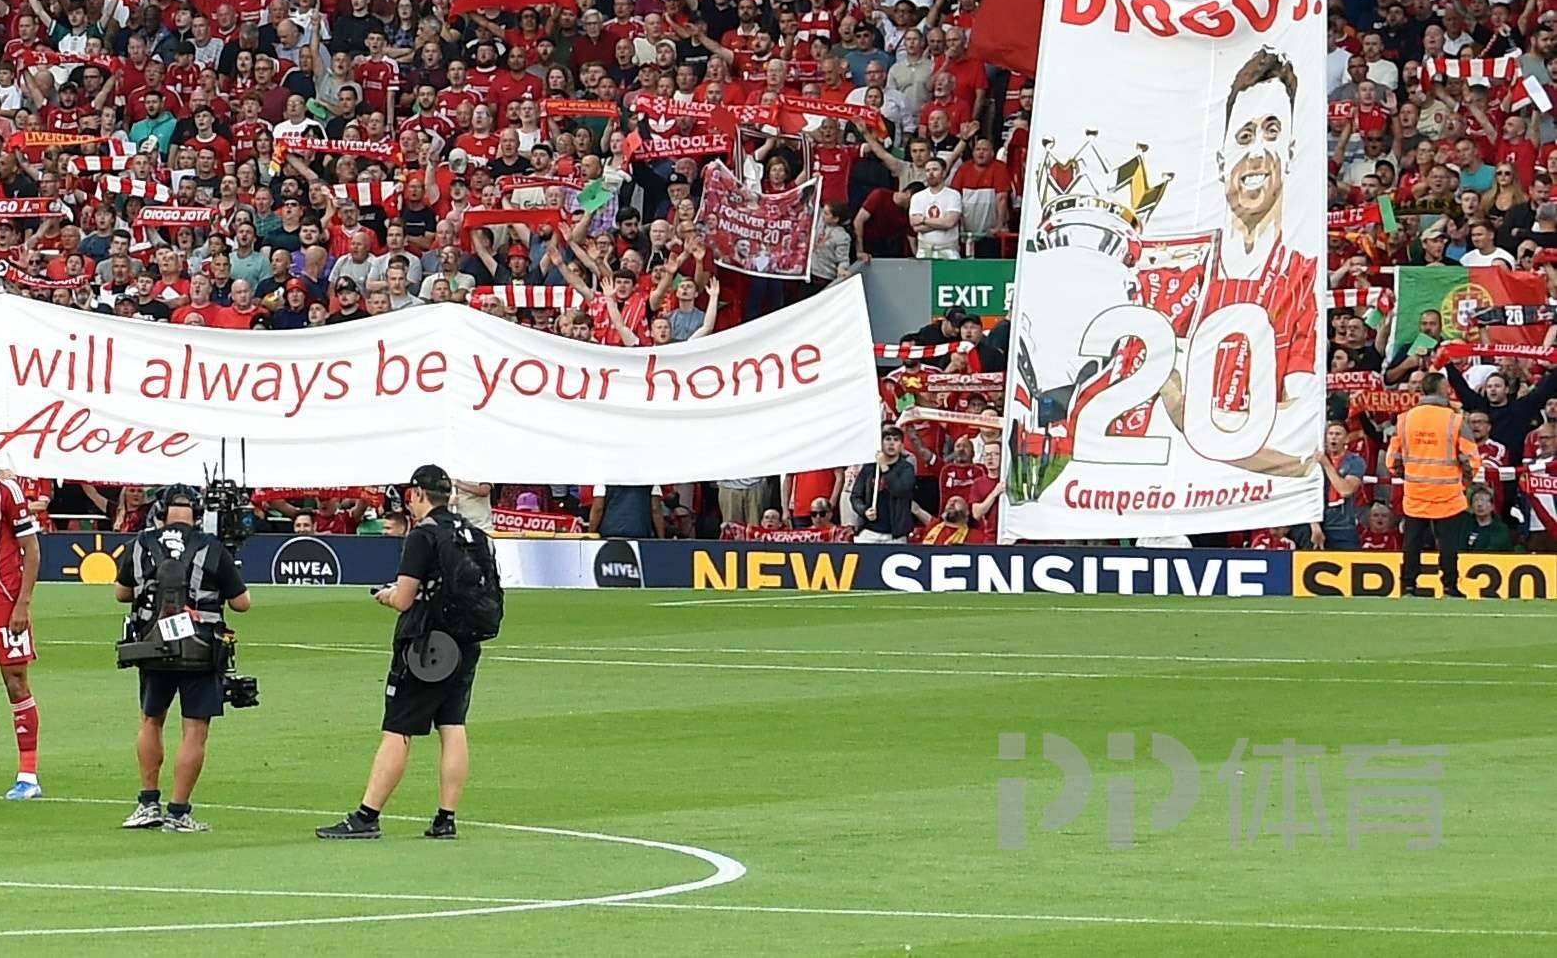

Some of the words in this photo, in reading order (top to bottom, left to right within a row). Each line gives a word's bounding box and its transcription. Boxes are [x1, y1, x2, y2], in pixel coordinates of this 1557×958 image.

[712, 134, 728, 146] FC
[143, 208, 180, 221] DIOGO
[181, 208, 210, 221] JOTA
[718, 206, 764, 227] FOREVER
[767, 218, 792, 231] OUR
[718, 221, 763, 241] NUMBER
[763, 231, 779, 245] 20
[938, 285, 993, 307] EXIT
[1505, 306, 1524, 325] 20
[9, 334, 113, 394] will
[140, 344, 352, 418] always
[375, 339, 447, 396] be
[472, 353, 619, 410] your
[646, 344, 821, 401] home
[1079, 301, 1277, 466] 20
[1063, 480, 1176, 516] Campeão
[492, 514, 522, 527] IOGO
[524, 517, 556, 531] JOTA
[280, 561, 333, 576] NIVEA
[693, 550, 860, 592] NEW
[880, 553, 1269, 598] SENSITIVE
